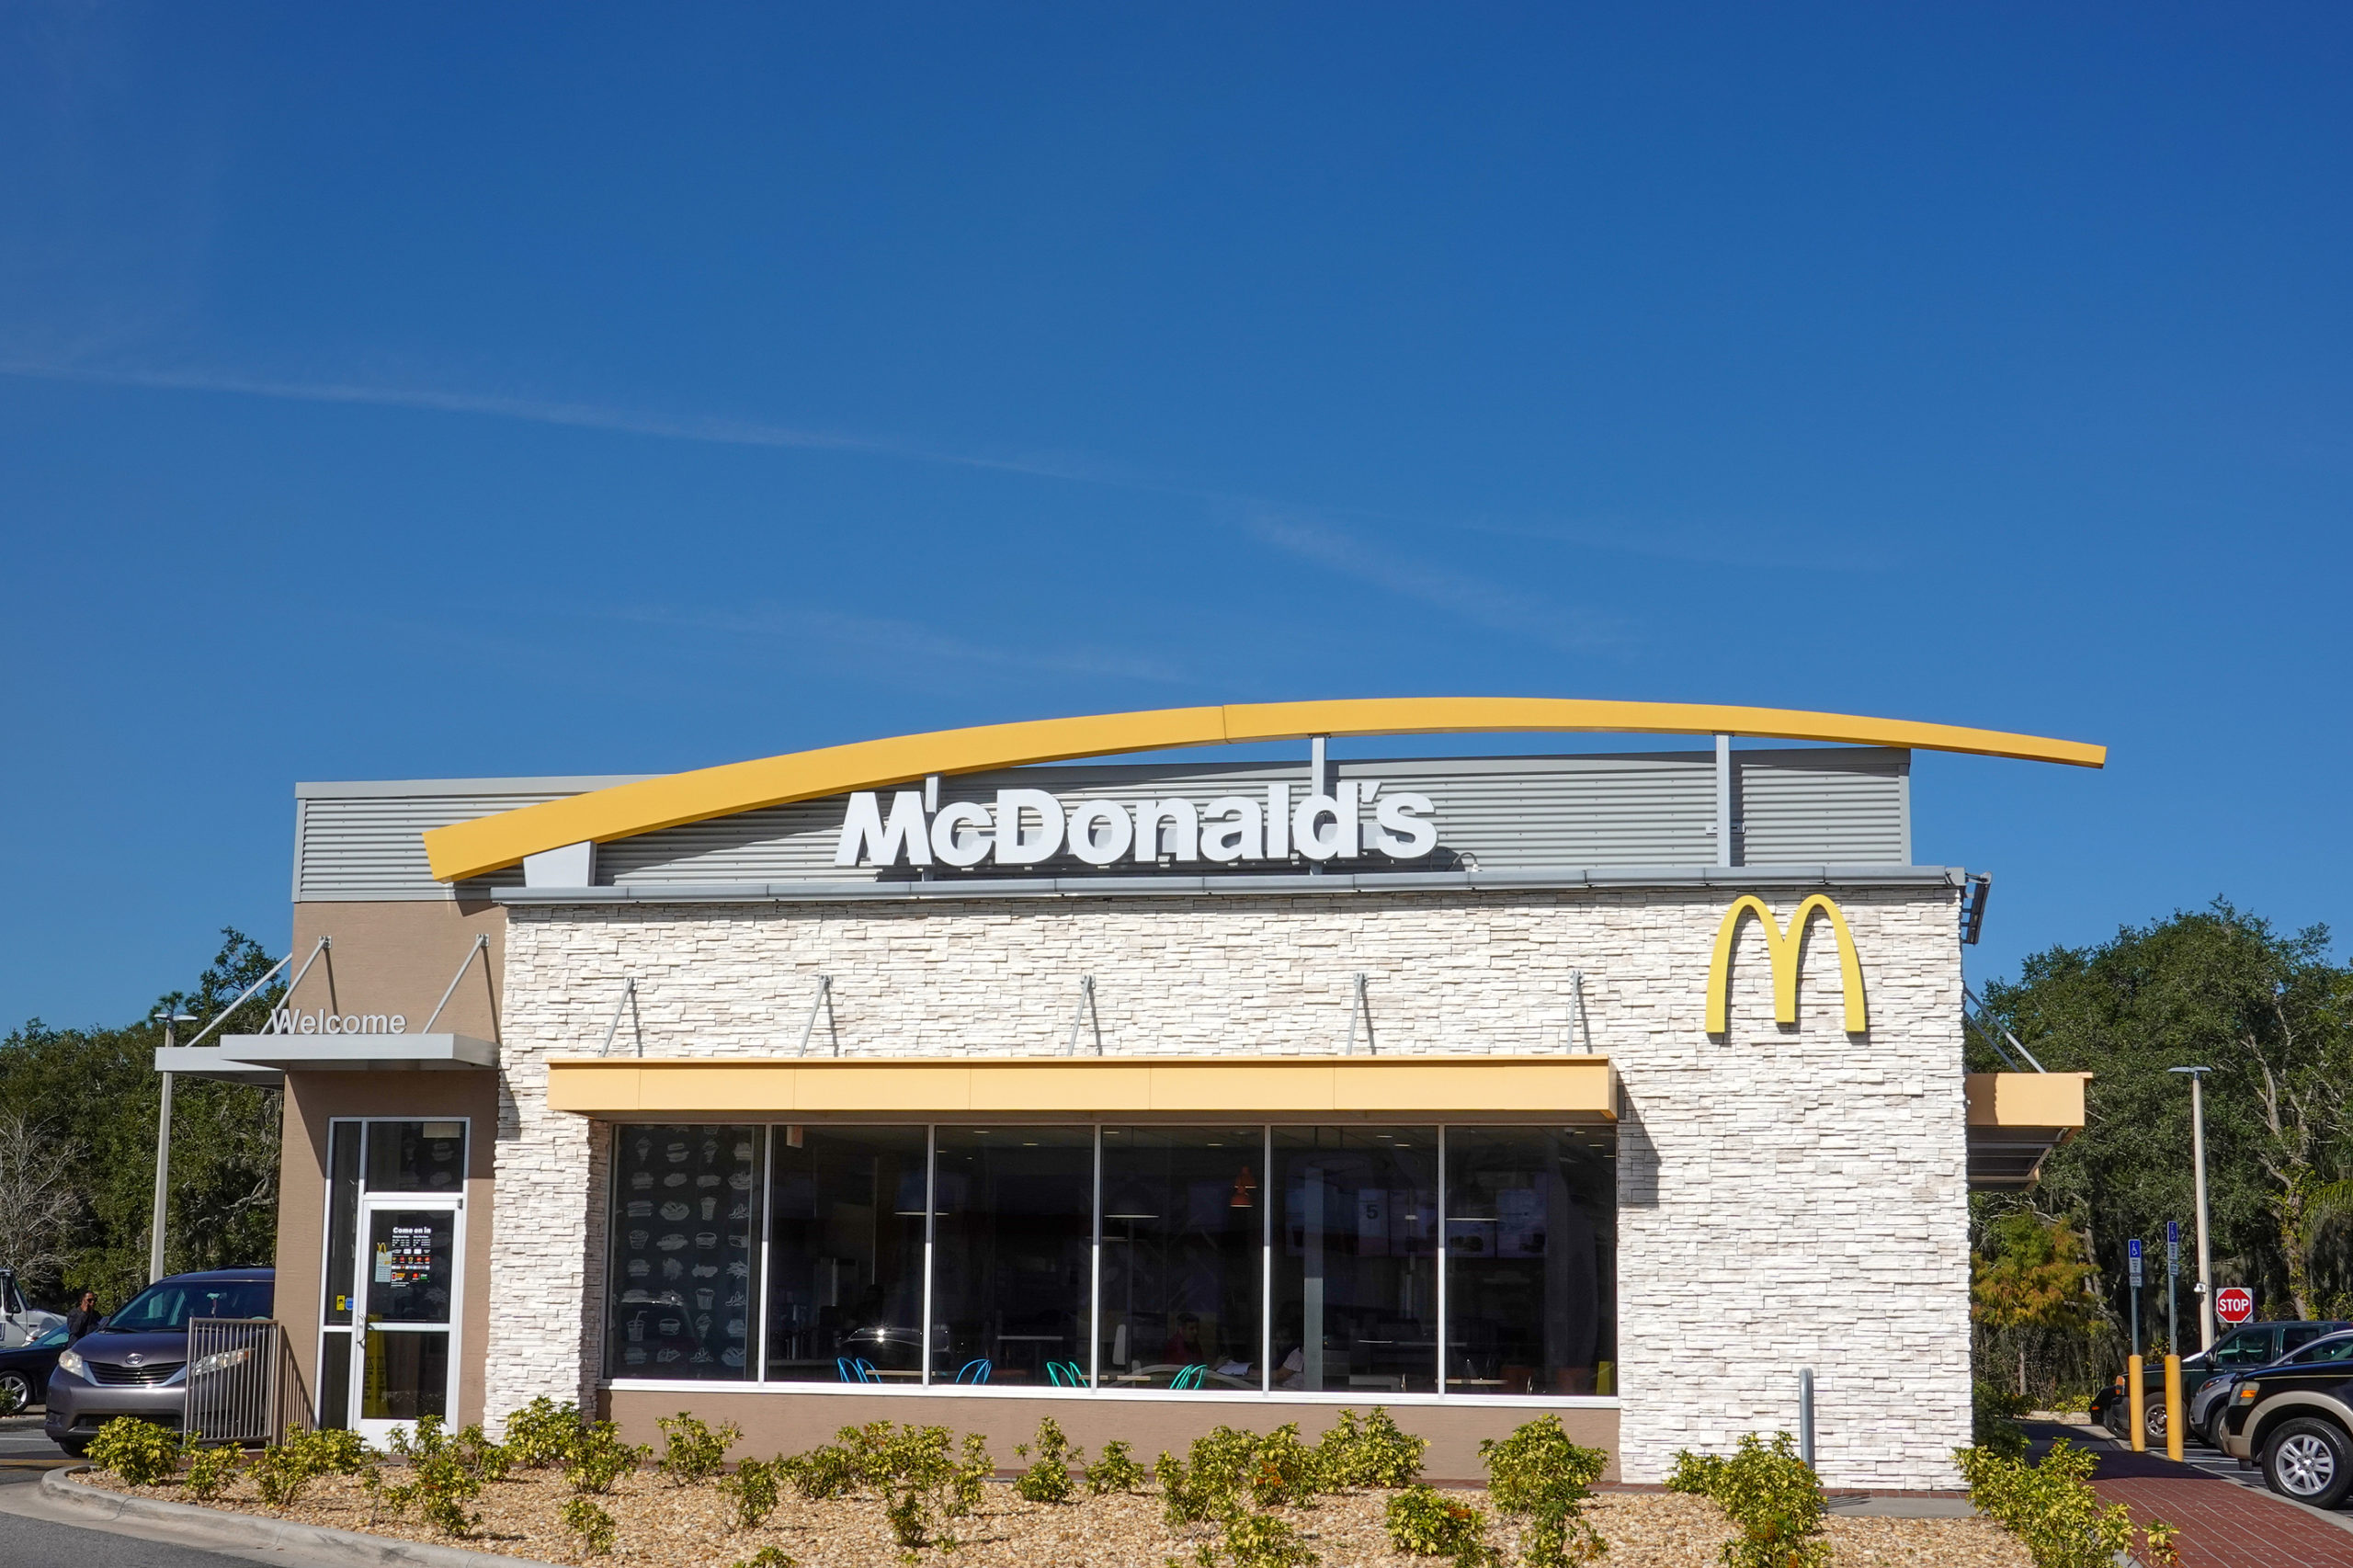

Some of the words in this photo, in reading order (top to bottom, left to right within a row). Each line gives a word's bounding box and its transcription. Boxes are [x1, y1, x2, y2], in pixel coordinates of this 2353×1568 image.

[835, 781, 1438, 869] McDonald's
[270, 1008, 407, 1035] Welcome
[2219, 1299, 2249, 1312] STOP
